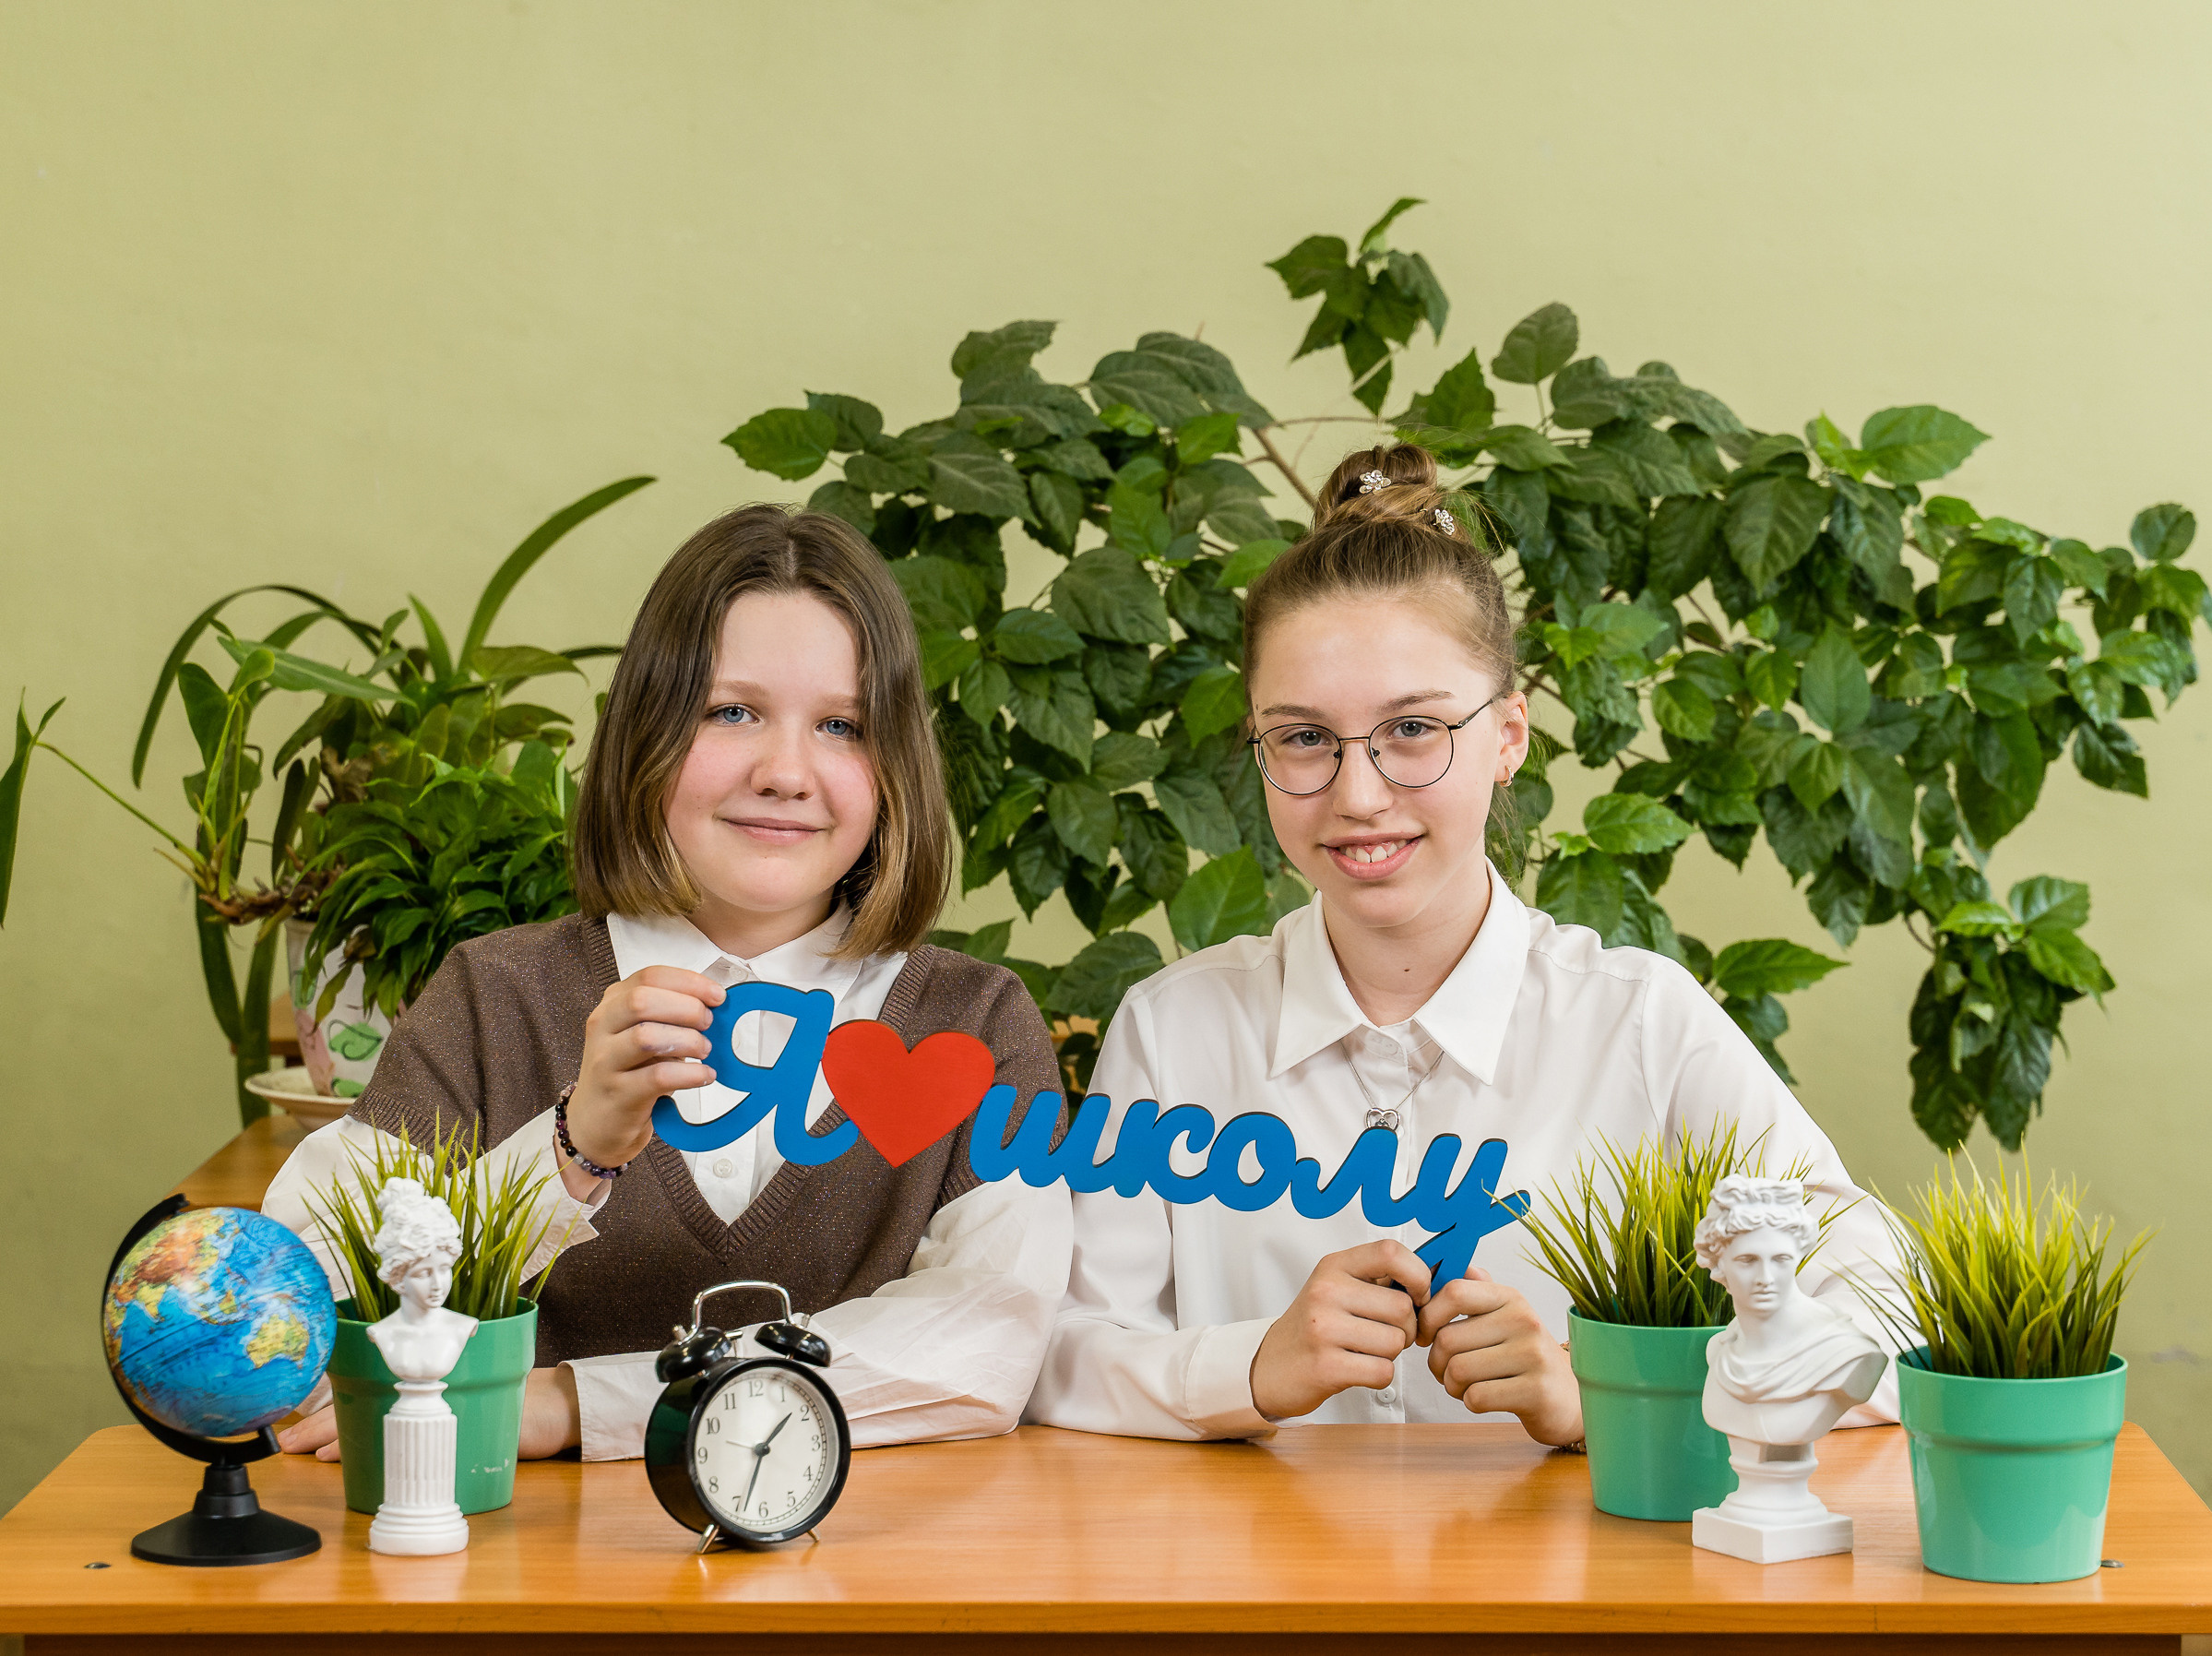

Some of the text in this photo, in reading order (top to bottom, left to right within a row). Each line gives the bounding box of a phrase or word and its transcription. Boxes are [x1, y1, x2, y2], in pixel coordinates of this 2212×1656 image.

[651, 981, 1531, 1303] Я школу
[748, 1379, 764, 1398] 12
[780, 1387, 786, 1402] 1
[724, 1393, 737, 1411] 11
[800, 1404, 810, 1422] 2
[707, 1417, 720, 1435] 10
[812, 1435, 821, 1451] 3
[697, 1447, 708, 1464] 9
[803, 1465, 814, 1482] 4
[708, 1476, 719, 1494] 8
[732, 1495, 742, 1512] 7
[786, 1491, 796, 1507] 5
[758, 1502, 769, 1519] 6
